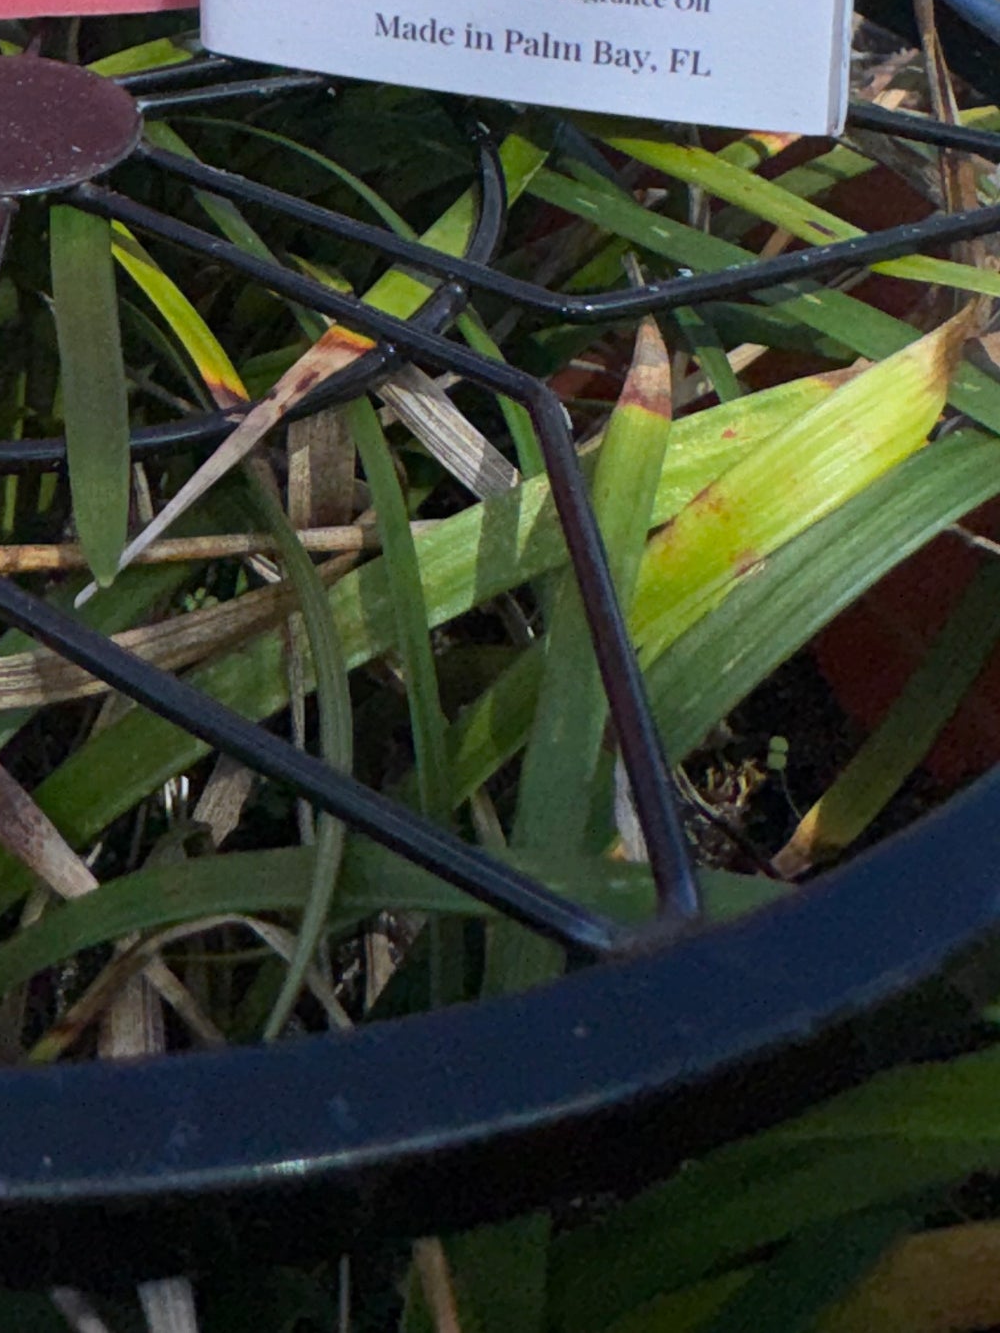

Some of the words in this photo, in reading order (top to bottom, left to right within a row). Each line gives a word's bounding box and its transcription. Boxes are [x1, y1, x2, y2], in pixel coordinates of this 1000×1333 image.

[374, 12, 455, 46] Made
[463, 23, 494, 51] in
[503, 31, 583, 62] Palm
[592, 41, 658, 74] Bay,
[668, 49, 712, 77] FL
